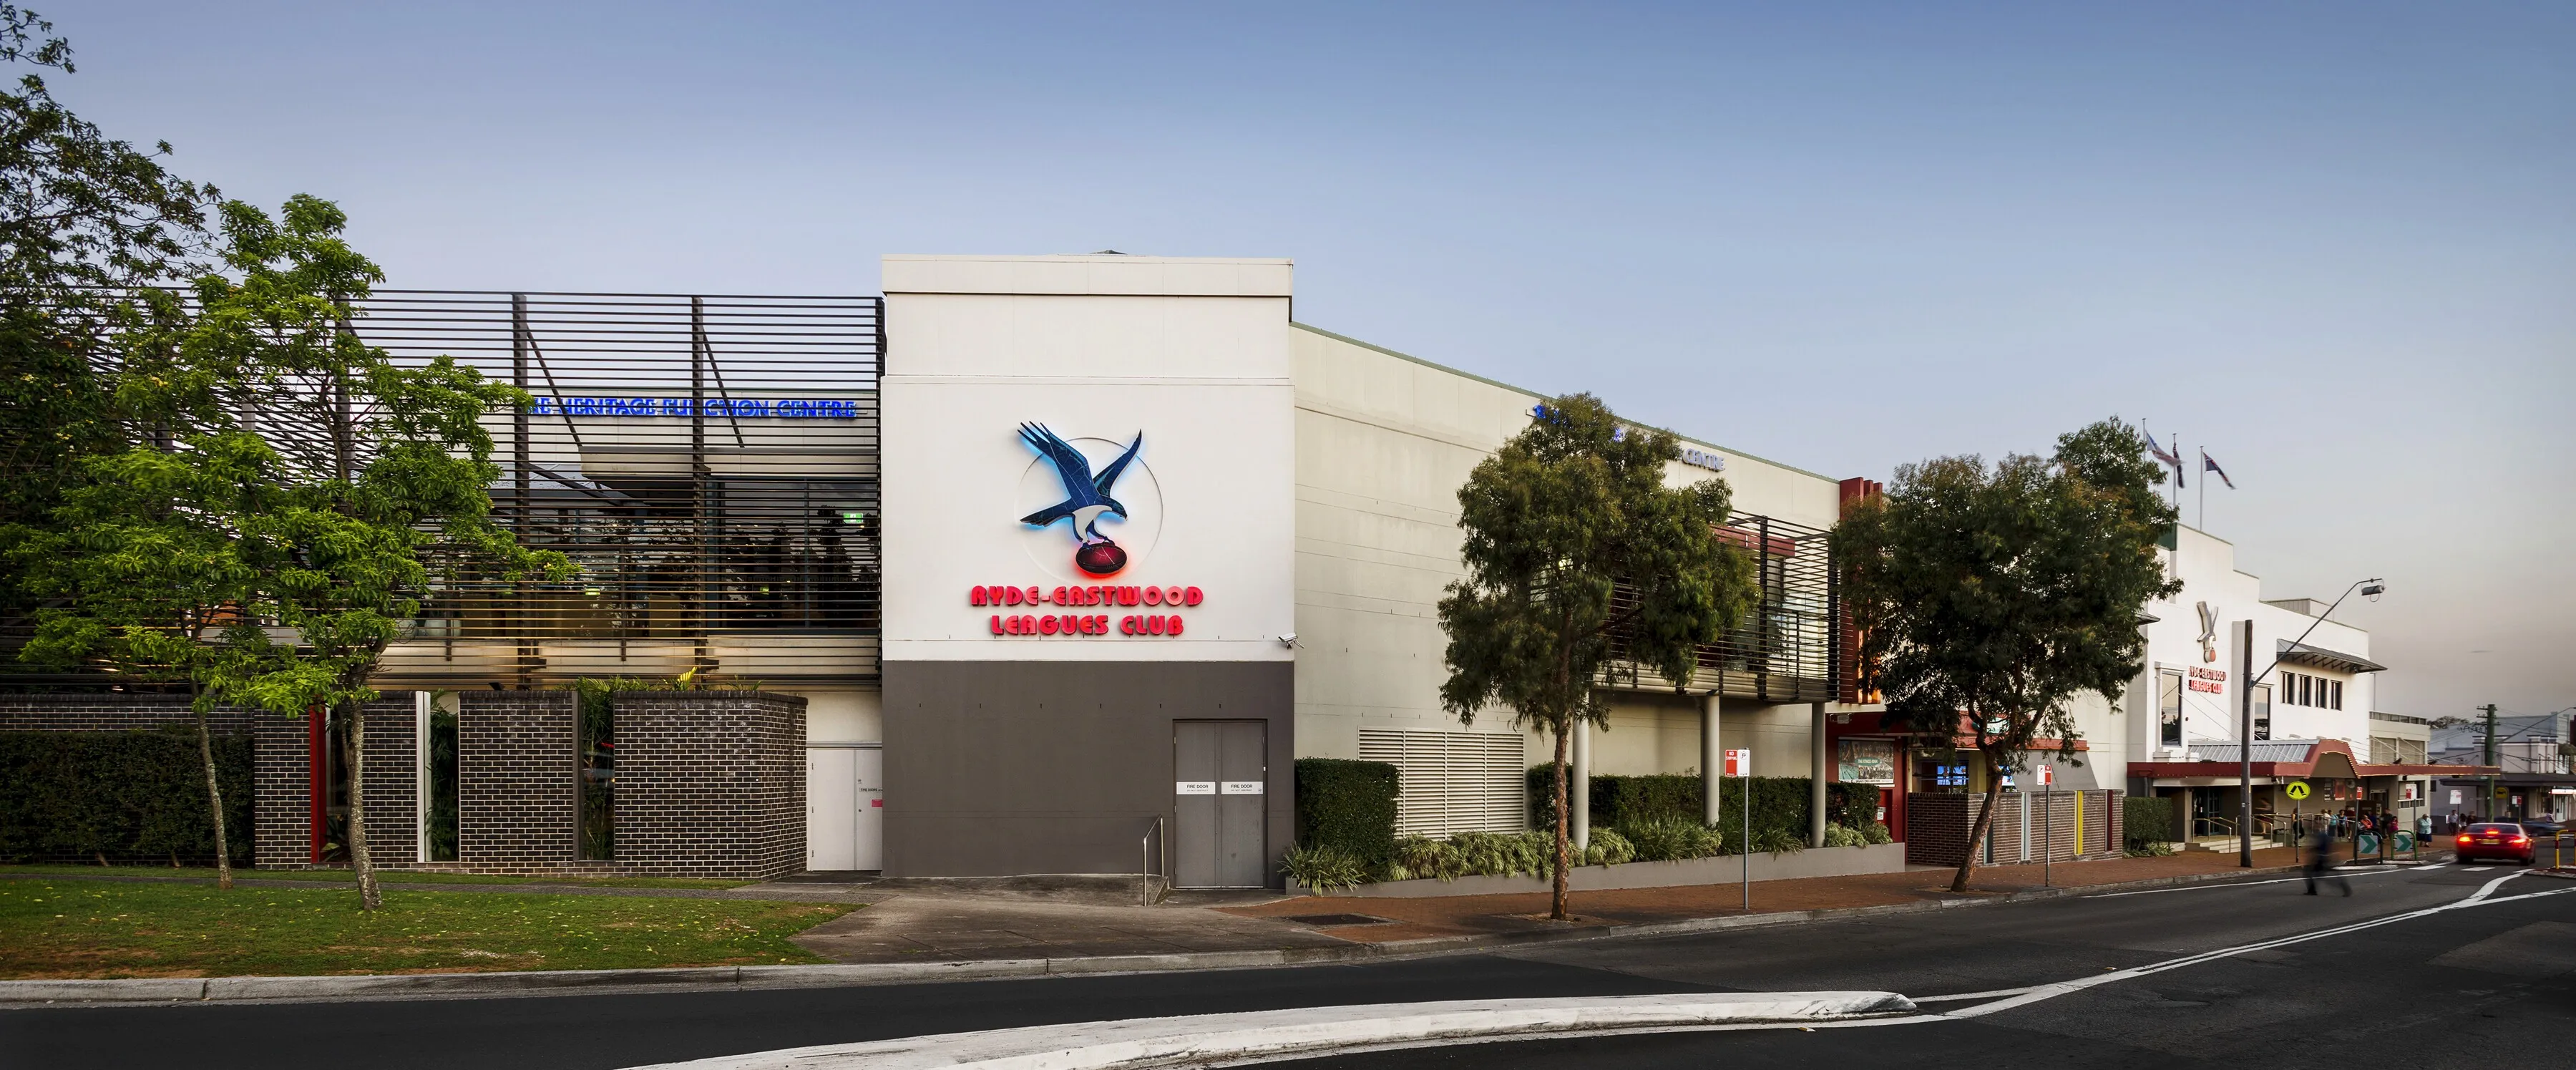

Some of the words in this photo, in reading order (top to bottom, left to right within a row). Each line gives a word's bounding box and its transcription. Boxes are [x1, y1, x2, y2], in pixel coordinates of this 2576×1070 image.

[559, 397, 658, 416] HERITAGE
[663, 398, 771, 417] FUCTION
[776, 399, 857, 417] CENTRE
[1682, 448, 1725, 472] CENTRE
[970, 585, 1204, 606] RYDE-EASTWOOD
[991, 614, 1109, 636] LEAGUES
[1120, 614, 1184, 636] CLUB
